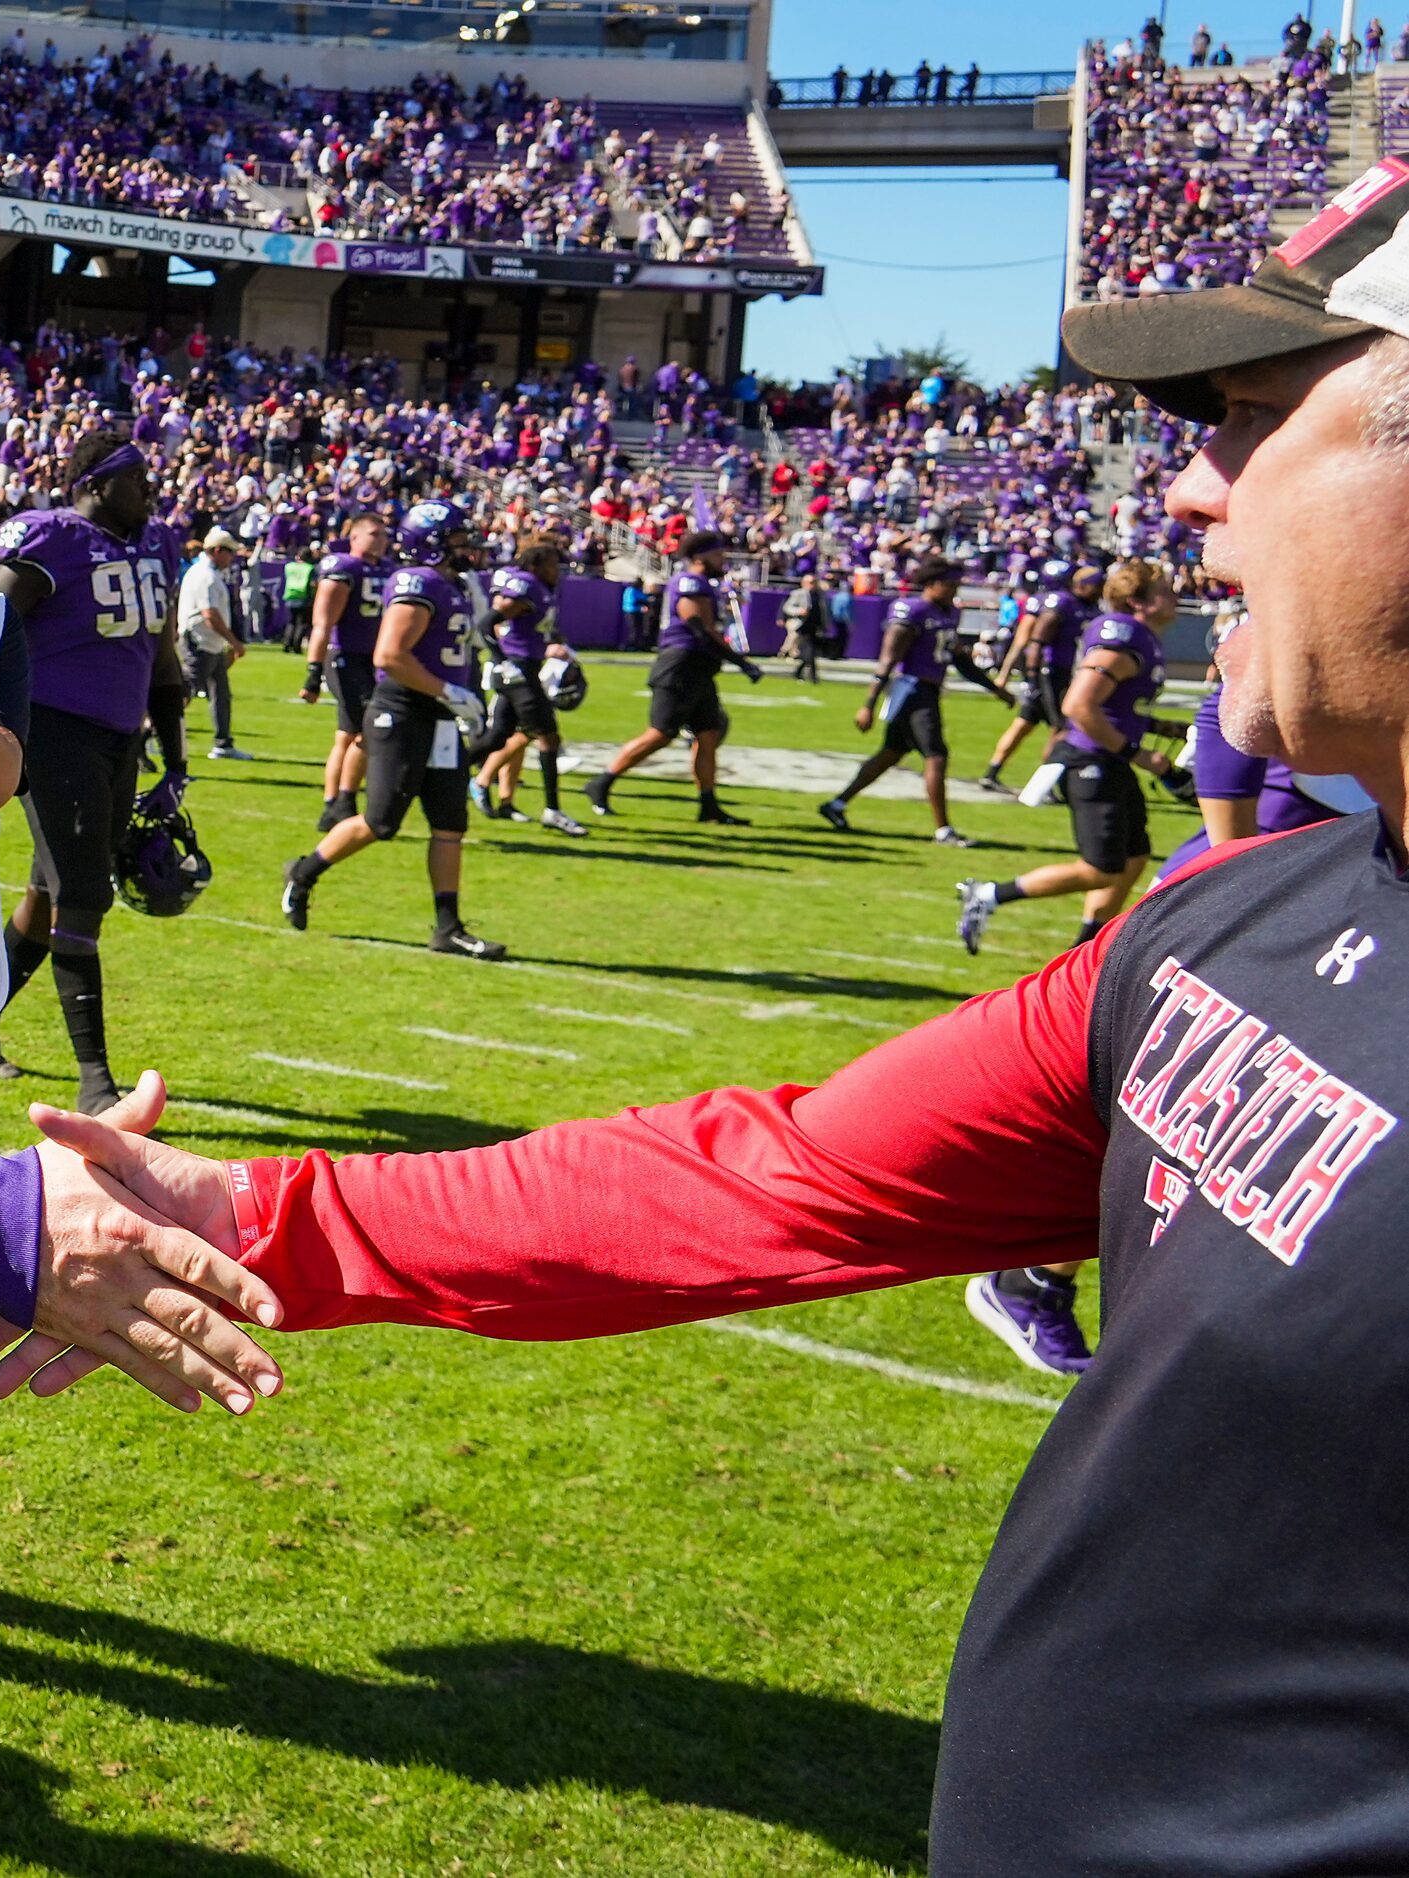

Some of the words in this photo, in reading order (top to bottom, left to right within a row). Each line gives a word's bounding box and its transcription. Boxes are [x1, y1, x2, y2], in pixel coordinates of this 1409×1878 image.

[45, 208, 103, 233] mavich
[109, 220, 180, 250] branding
[184, 231, 235, 252] group
[350, 248, 374, 269] Go
[92, 557, 167, 638] 96
[441, 612, 474, 667] 3
